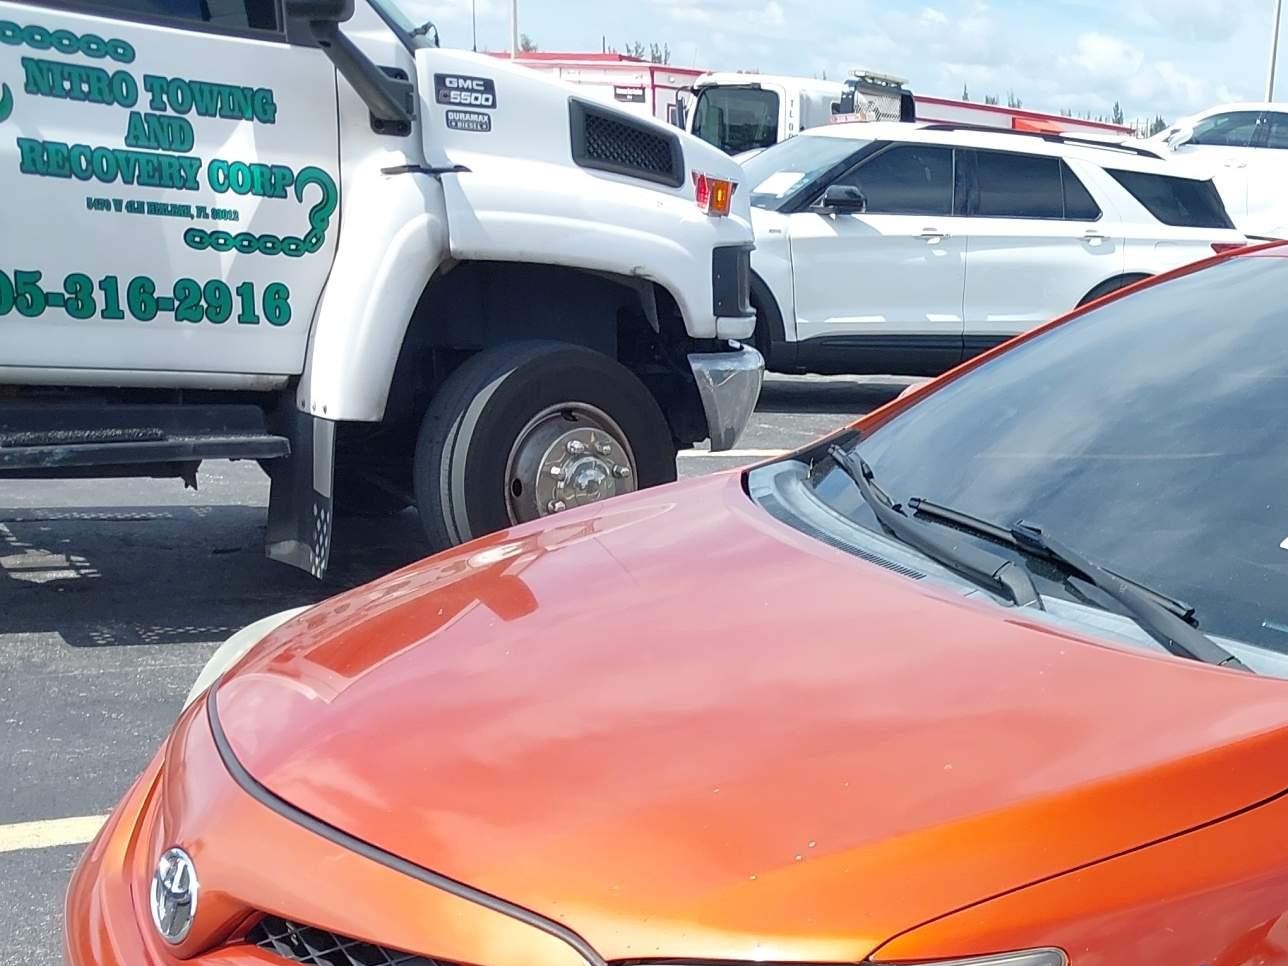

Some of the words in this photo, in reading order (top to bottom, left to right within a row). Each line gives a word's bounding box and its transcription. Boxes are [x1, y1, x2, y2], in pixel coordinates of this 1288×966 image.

[21, 57, 138, 108] NITRO
[143, 74, 276, 124] TOWING
[445, 78, 485, 90] GMC
[125, 111, 194, 152] AND
[447, 111, 489, 122] DURAMAX
[17, 137, 202, 191] RECOVERY
[208, 158, 293, 199] CORP
